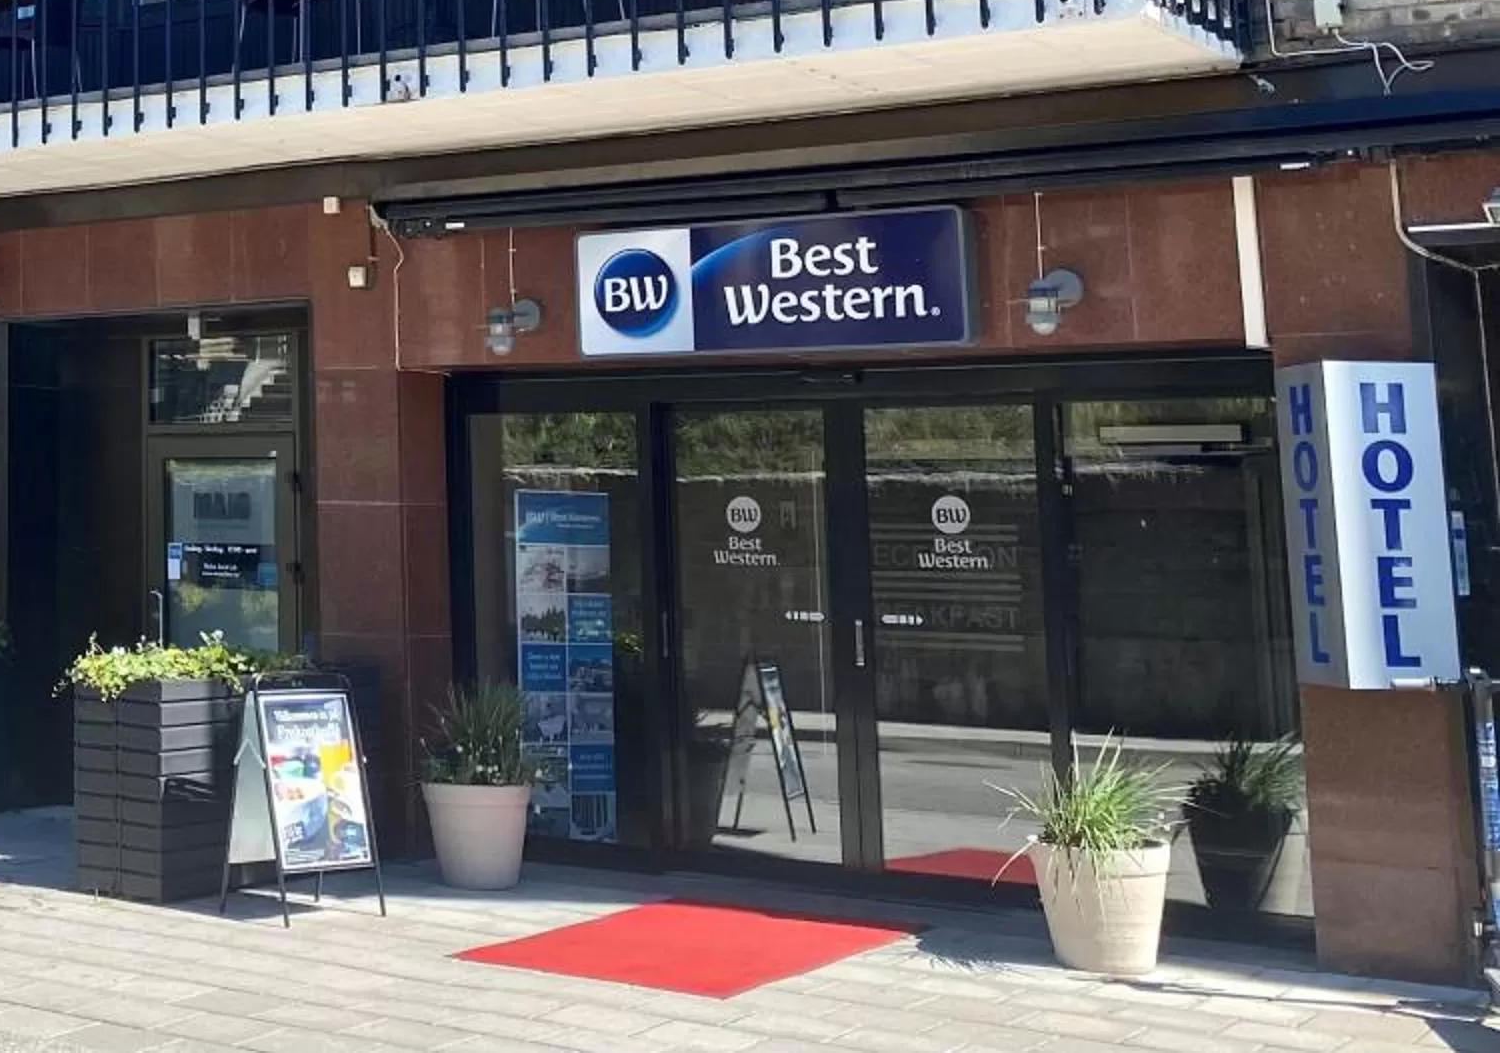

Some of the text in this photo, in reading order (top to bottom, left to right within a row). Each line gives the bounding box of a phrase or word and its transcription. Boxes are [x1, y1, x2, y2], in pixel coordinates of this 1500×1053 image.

[769, 236, 879, 280] Best
[603, 274, 669, 314] BW
[729, 507, 758, 524] BW
[936, 507, 968, 524] BW
[1289, 383, 1331, 664] HOTEL
[1359, 382, 1422, 668] HOTEL
[728, 536, 763, 551] Best
[934, 537, 973, 554] Best
